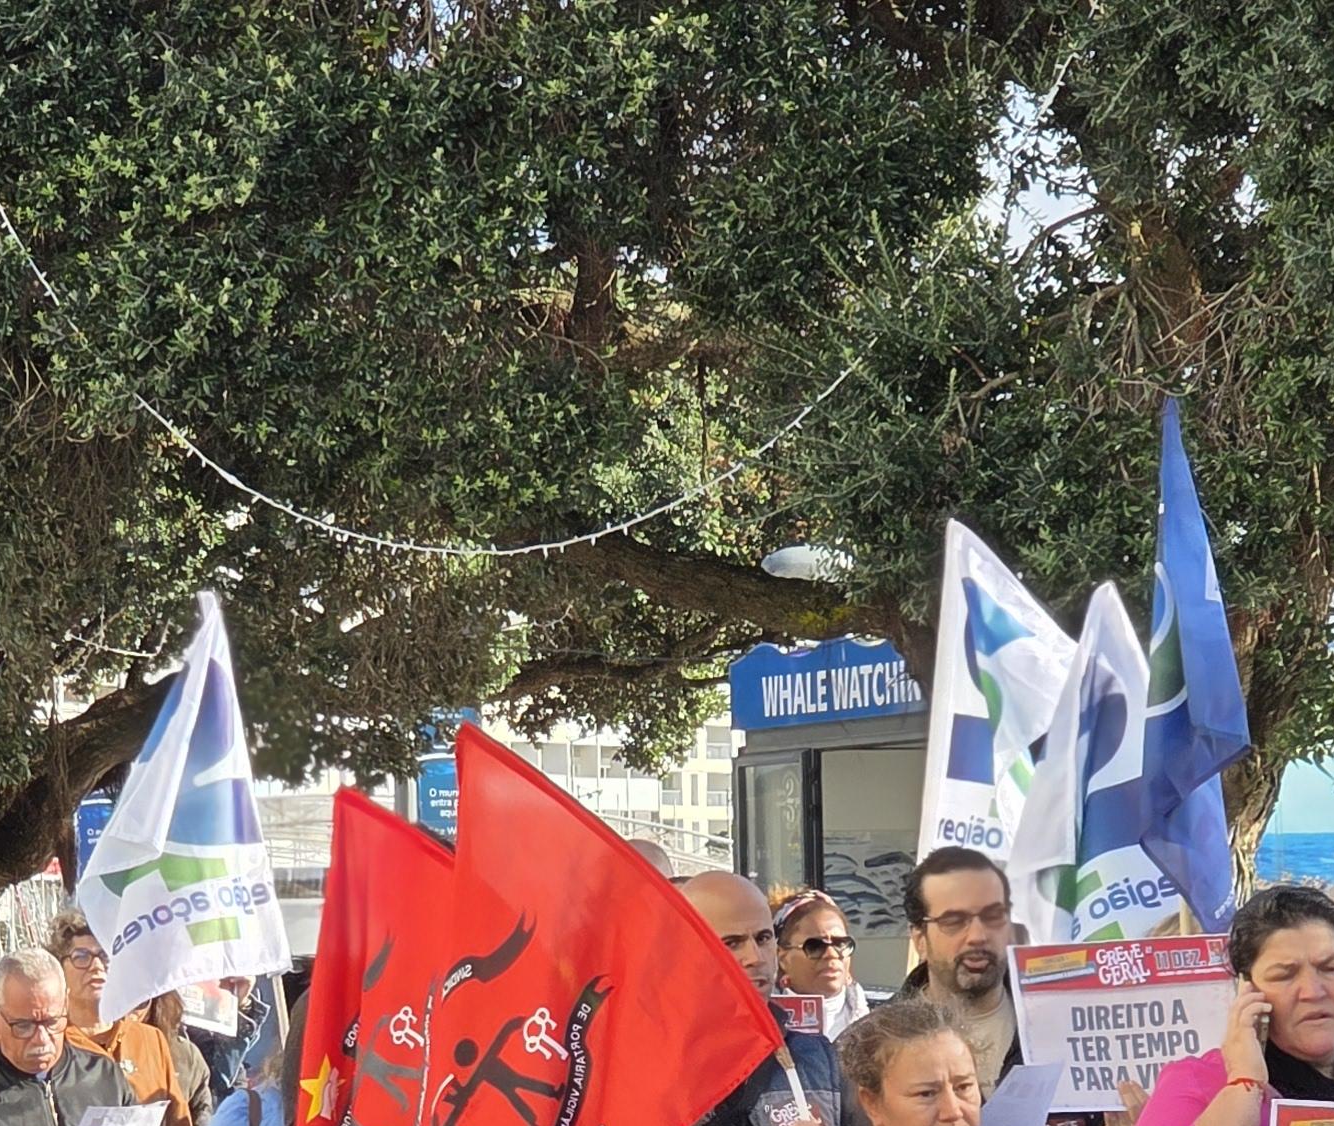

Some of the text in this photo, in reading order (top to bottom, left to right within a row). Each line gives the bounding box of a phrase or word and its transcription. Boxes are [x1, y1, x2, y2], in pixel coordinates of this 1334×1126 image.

[761, 669, 828, 718] WHALE
[937, 814, 1004, 850] região
[1095, 942, 1144, 965] GREVE
[1170, 948, 1207, 969] DEZ.
[1098, 960, 1151, 987] GERAL
[1070, 998, 1189, 1032] DIREITO A
[1066, 1029, 1201, 1062] TER TEMPO
[1070, 1063, 1130, 1091] PARA
